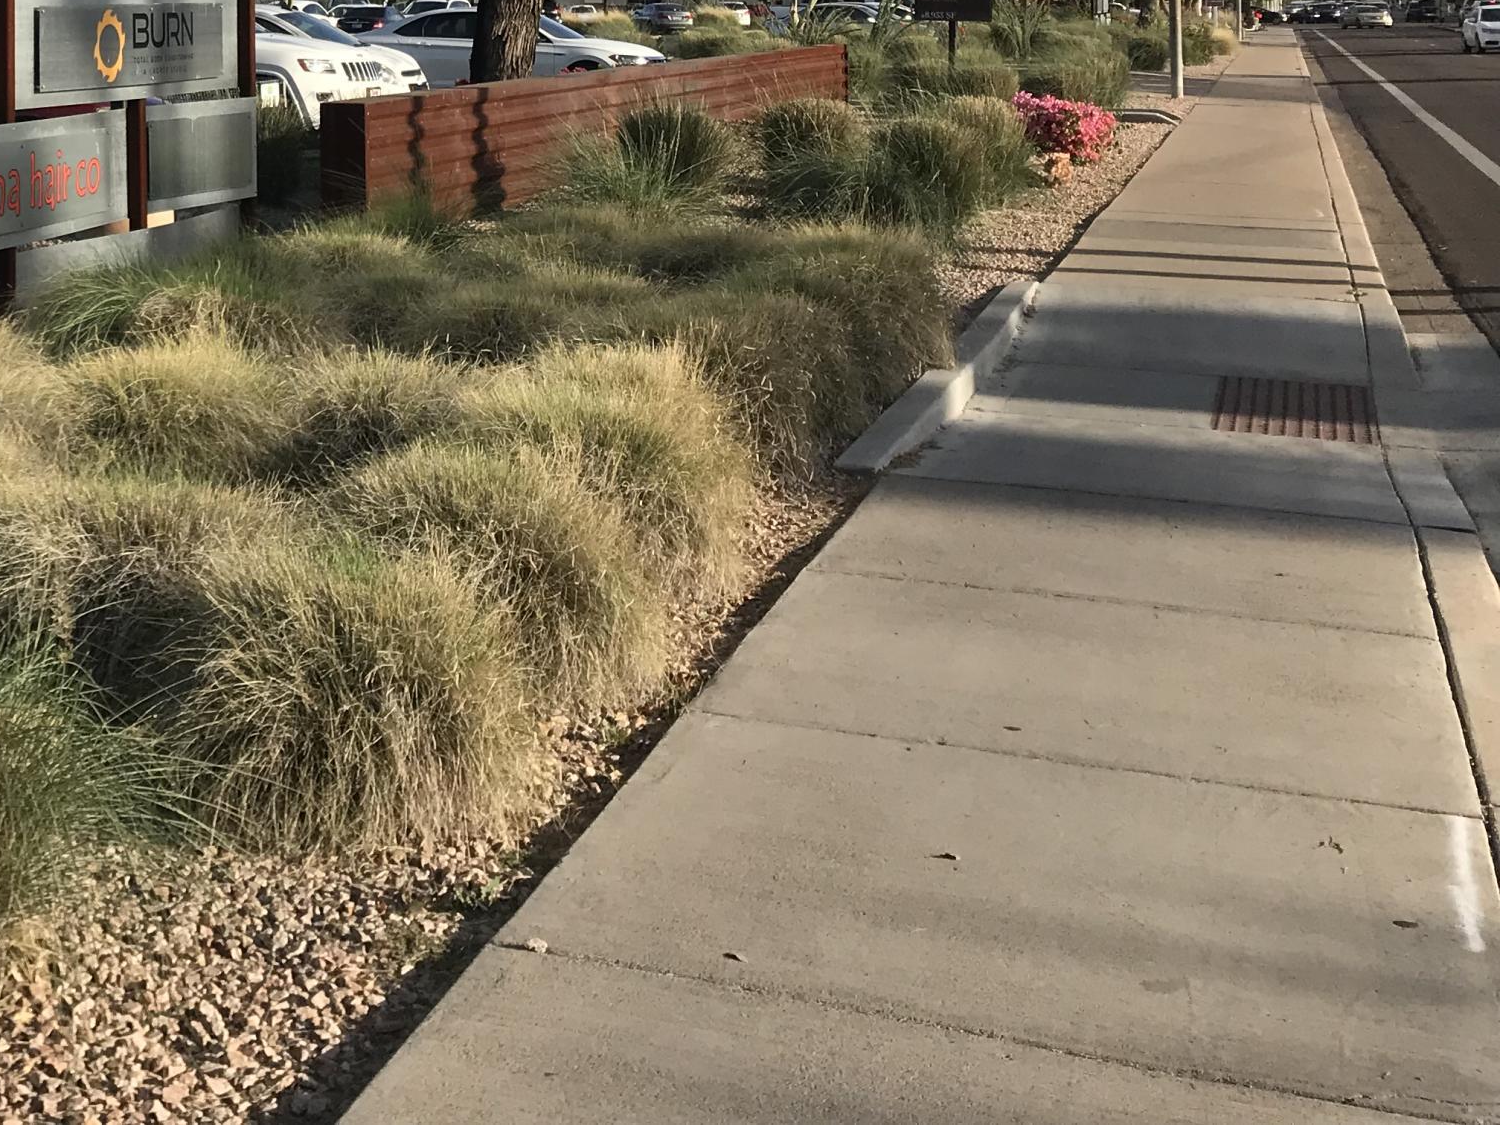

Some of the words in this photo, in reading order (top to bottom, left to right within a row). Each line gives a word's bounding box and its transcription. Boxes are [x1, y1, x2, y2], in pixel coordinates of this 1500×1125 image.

[132, 12, 194, 49] BURN
[29, 150, 72, 211] hair
[75, 157, 101, 197] co
